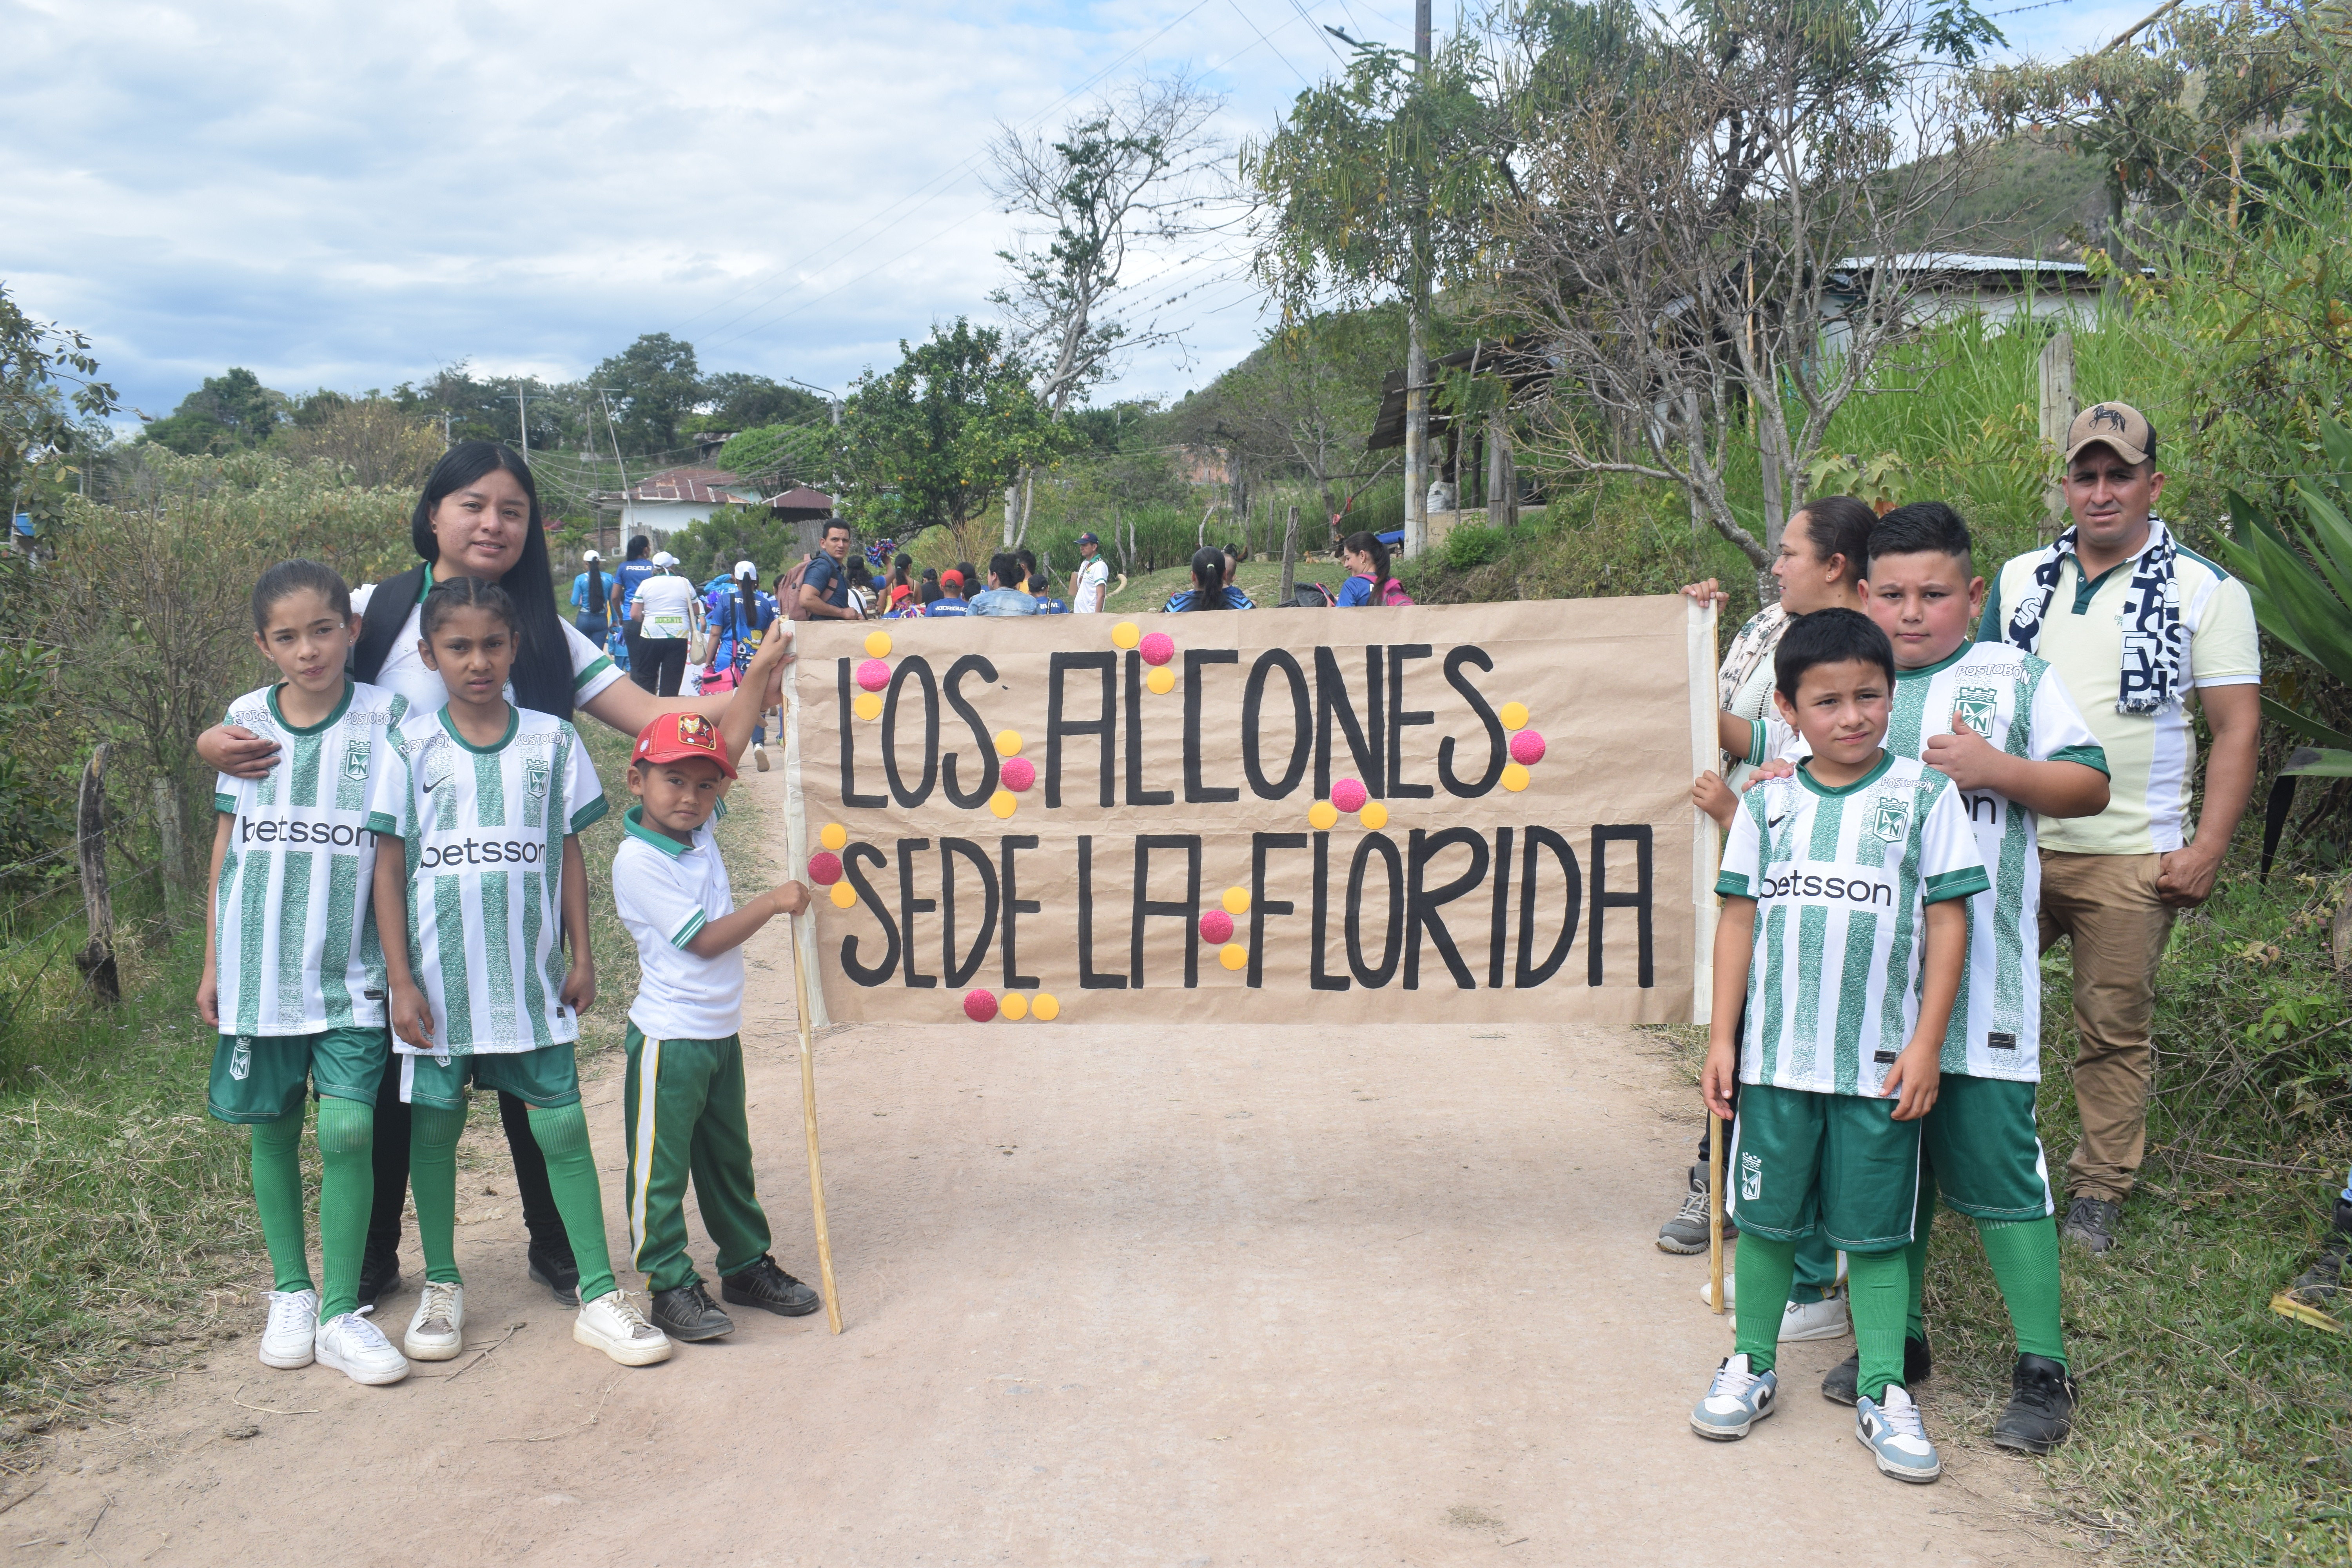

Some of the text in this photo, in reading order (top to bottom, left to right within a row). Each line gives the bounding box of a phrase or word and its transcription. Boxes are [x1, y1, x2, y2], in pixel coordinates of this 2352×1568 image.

[838, 644, 1506, 809] LOS ALCONES
[242, 815, 374, 848] betsson
[840, 824, 1654, 991] SEDE LA FLORIDA
